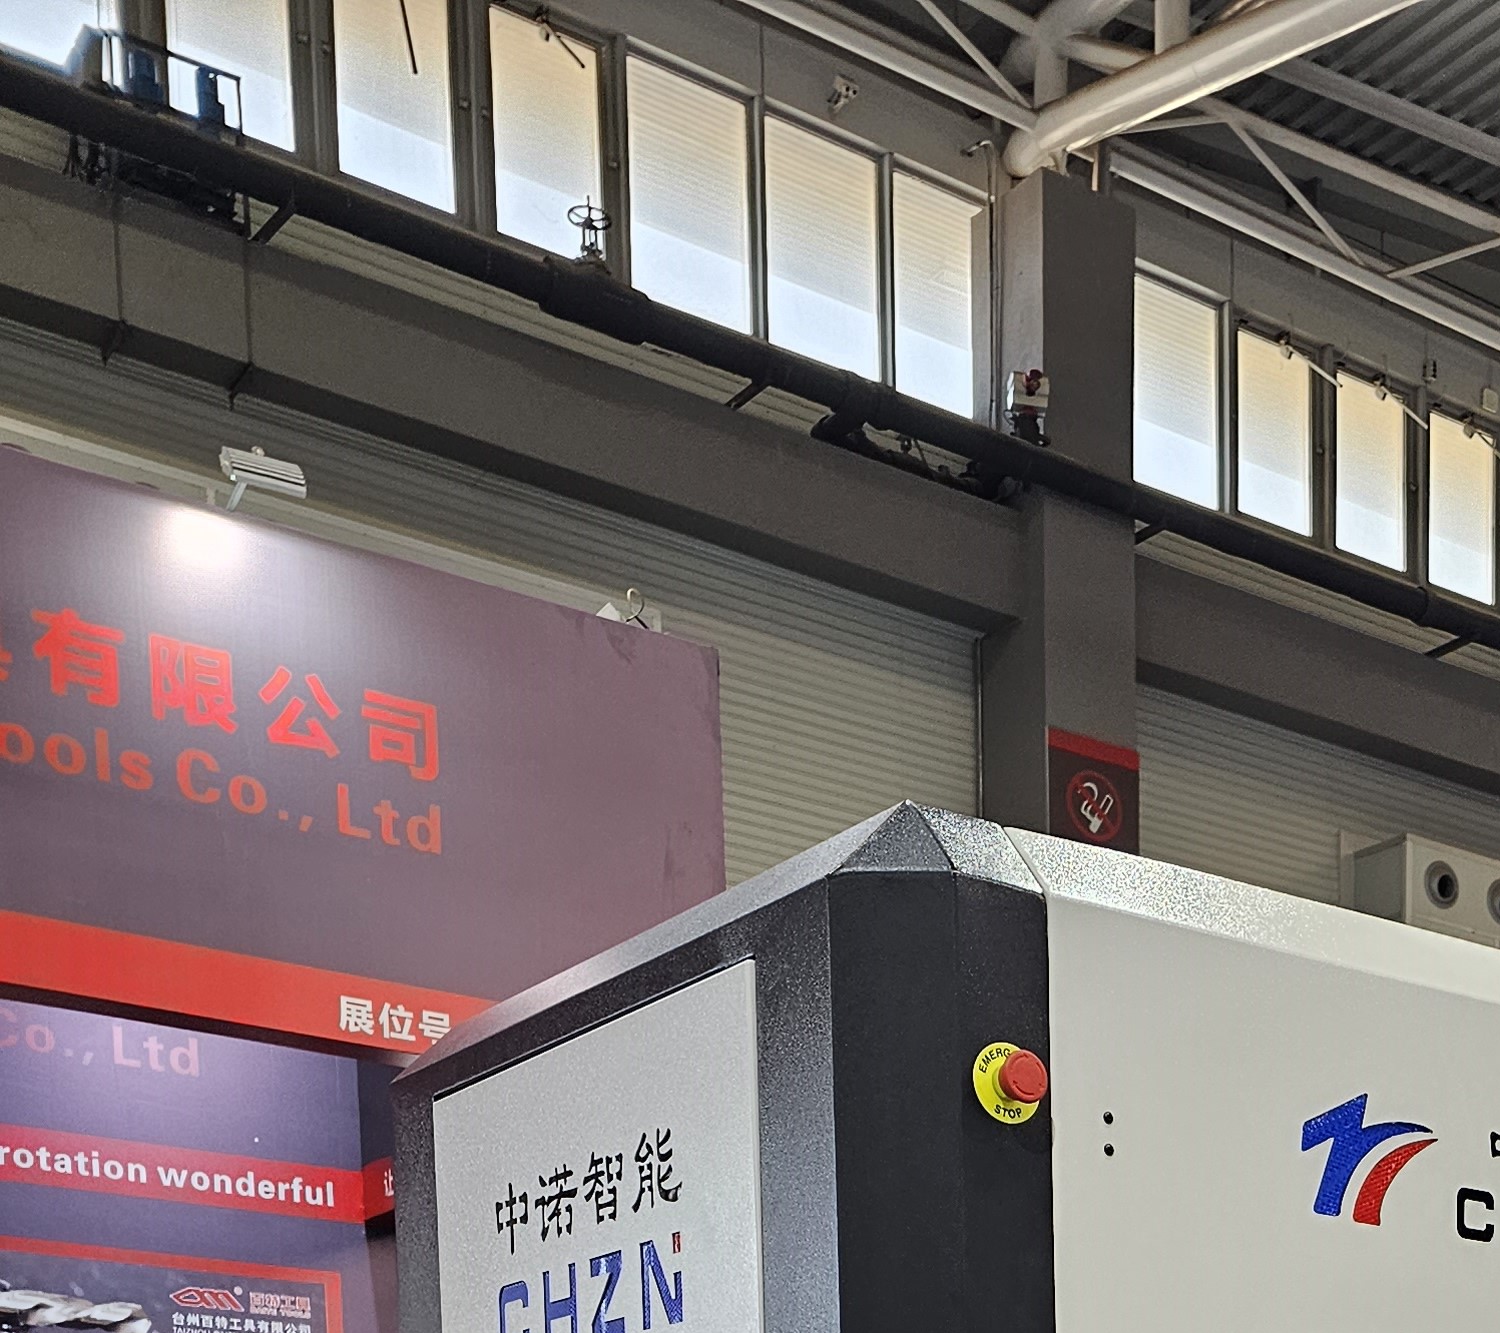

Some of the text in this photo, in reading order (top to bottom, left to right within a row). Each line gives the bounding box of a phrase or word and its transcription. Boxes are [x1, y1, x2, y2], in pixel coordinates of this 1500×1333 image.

[0, 608, 441, 782] 有限公司
[176, 748, 313, 832] Co.,
[337, 784, 442, 854] Ltd
[112, 1024, 201, 1078] Ltd
[994, 1104, 1022, 1119] STOP
[0, 1145, 147, 1184] rotation
[157, 1165, 335, 1208] wonderful
[495, 1127, 683, 1255] 中诺智能
